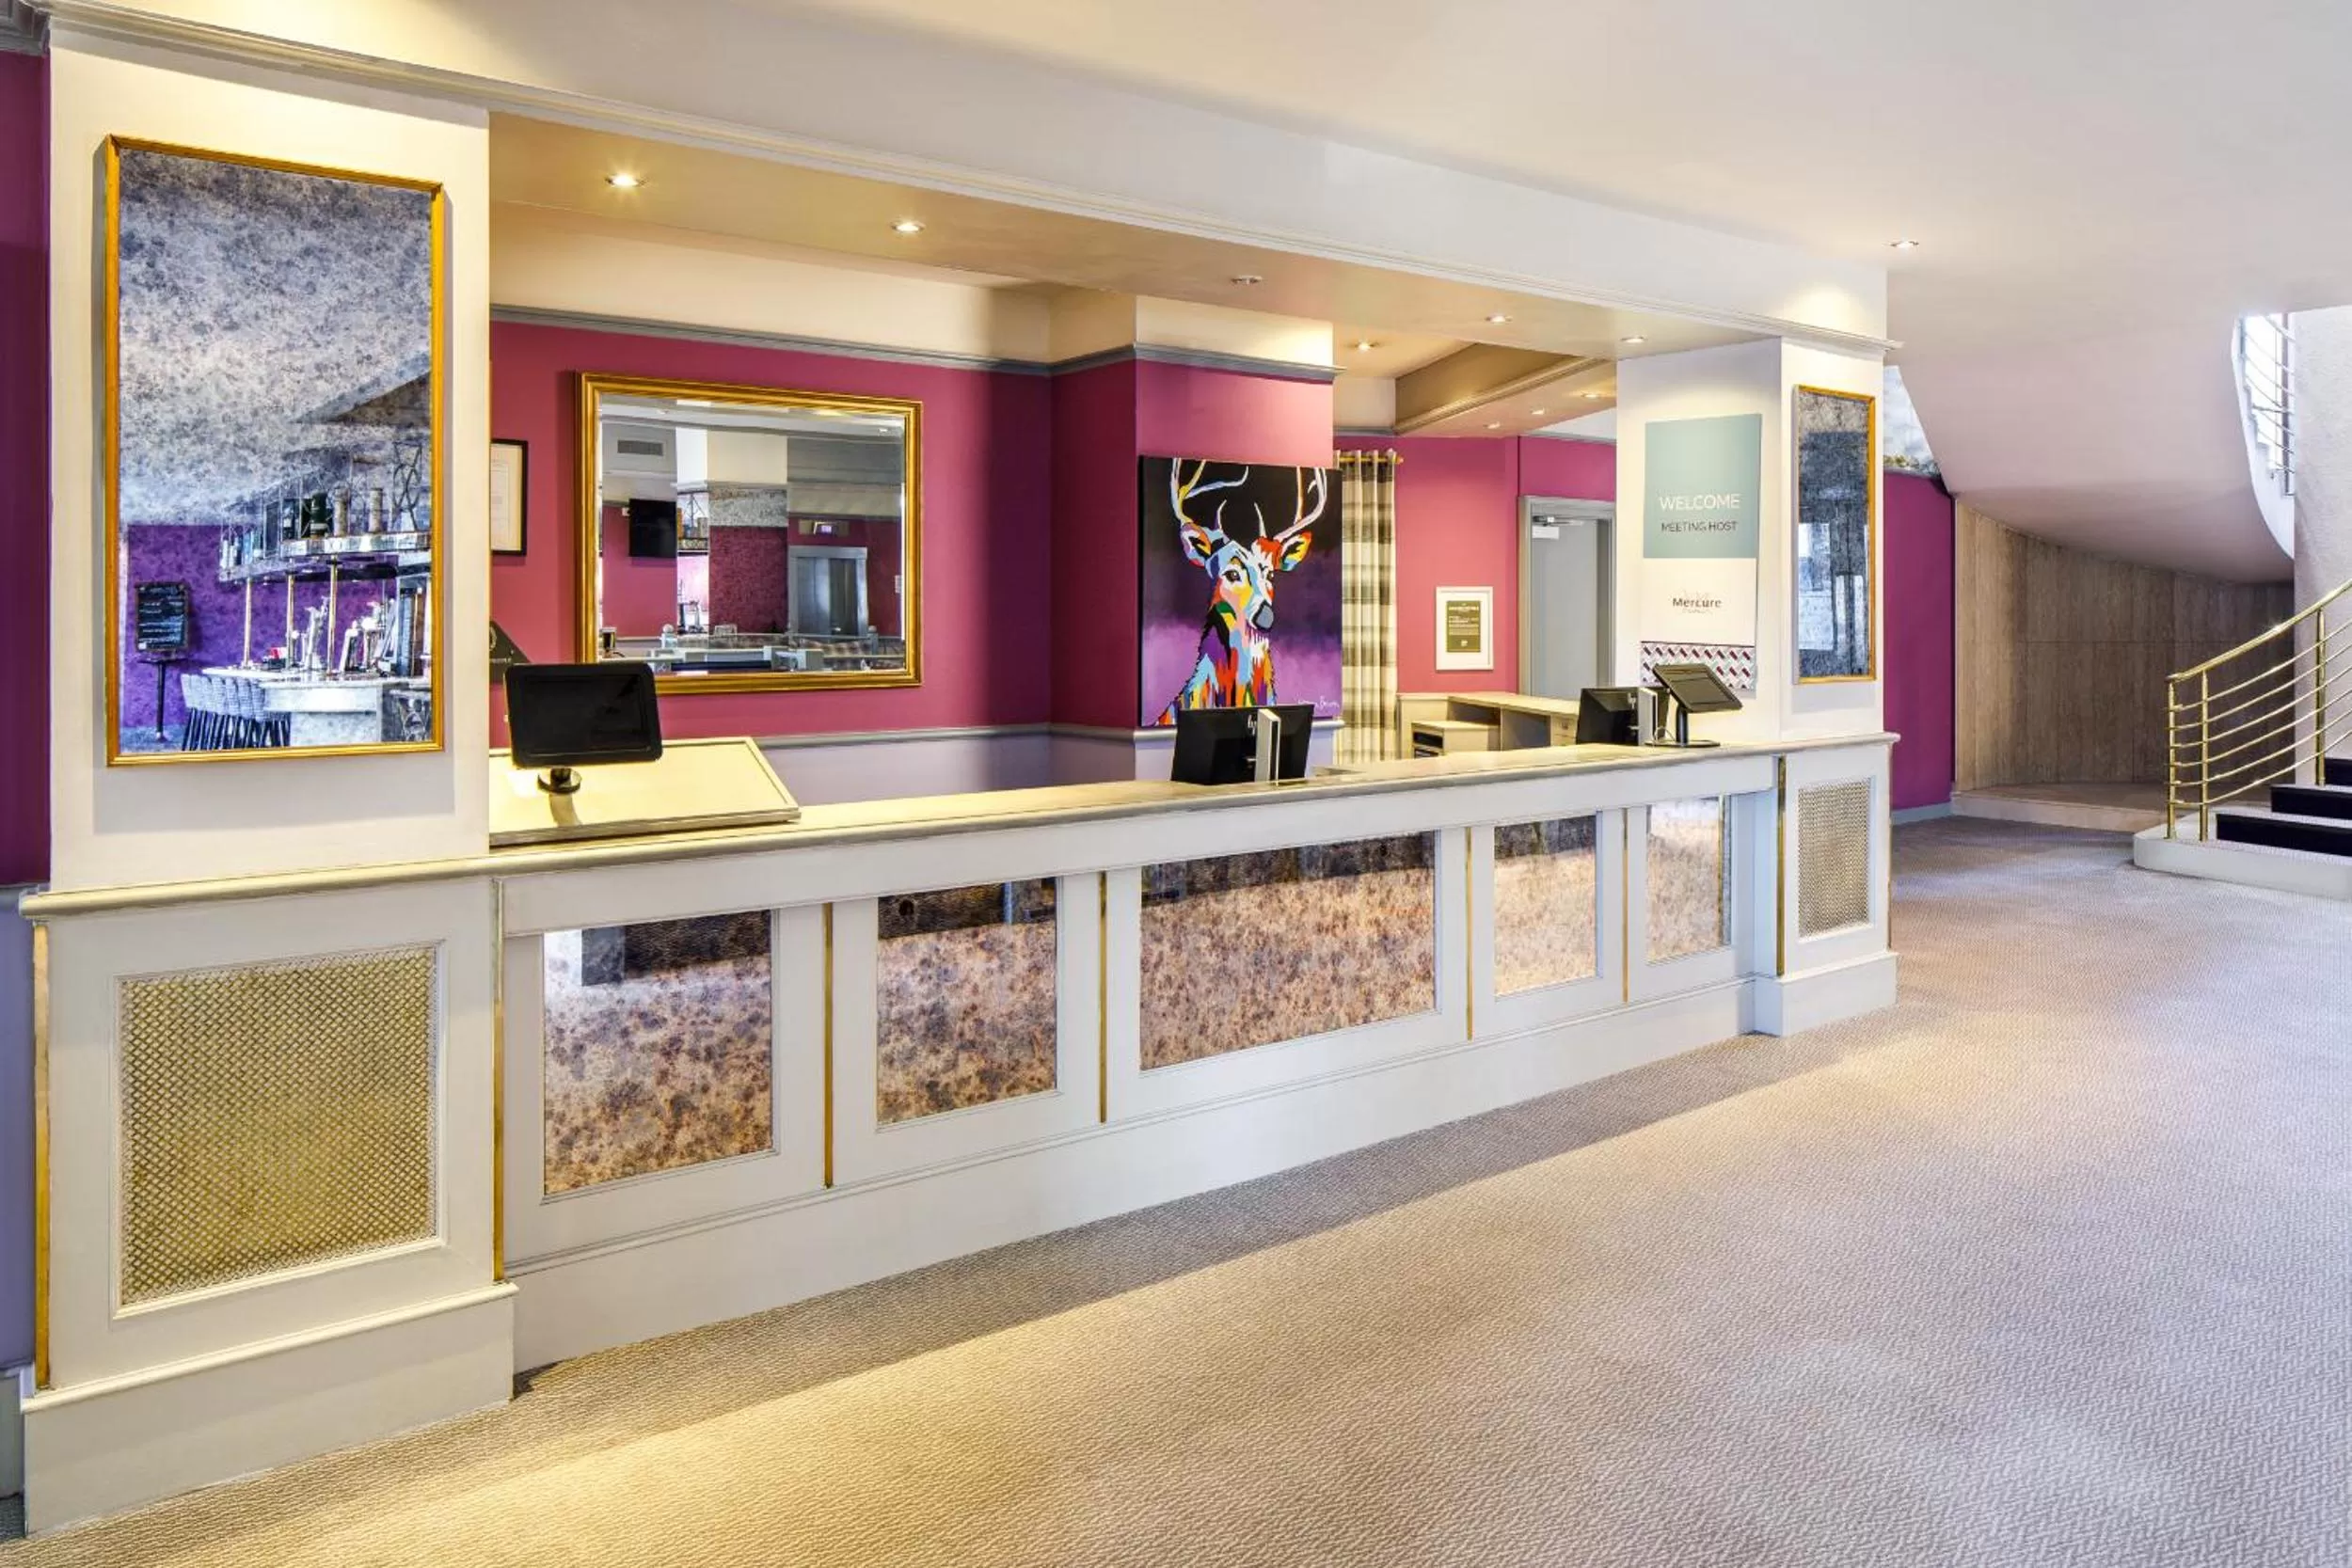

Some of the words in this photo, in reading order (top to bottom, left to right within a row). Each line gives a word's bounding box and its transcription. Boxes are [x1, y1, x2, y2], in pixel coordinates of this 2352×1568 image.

[1660, 494, 1740, 511] WELCOME
[1661, 521, 1708, 532] MEETING
[1708, 520, 1738, 531] HOST
[1673, 597, 1722, 608] Mercure
